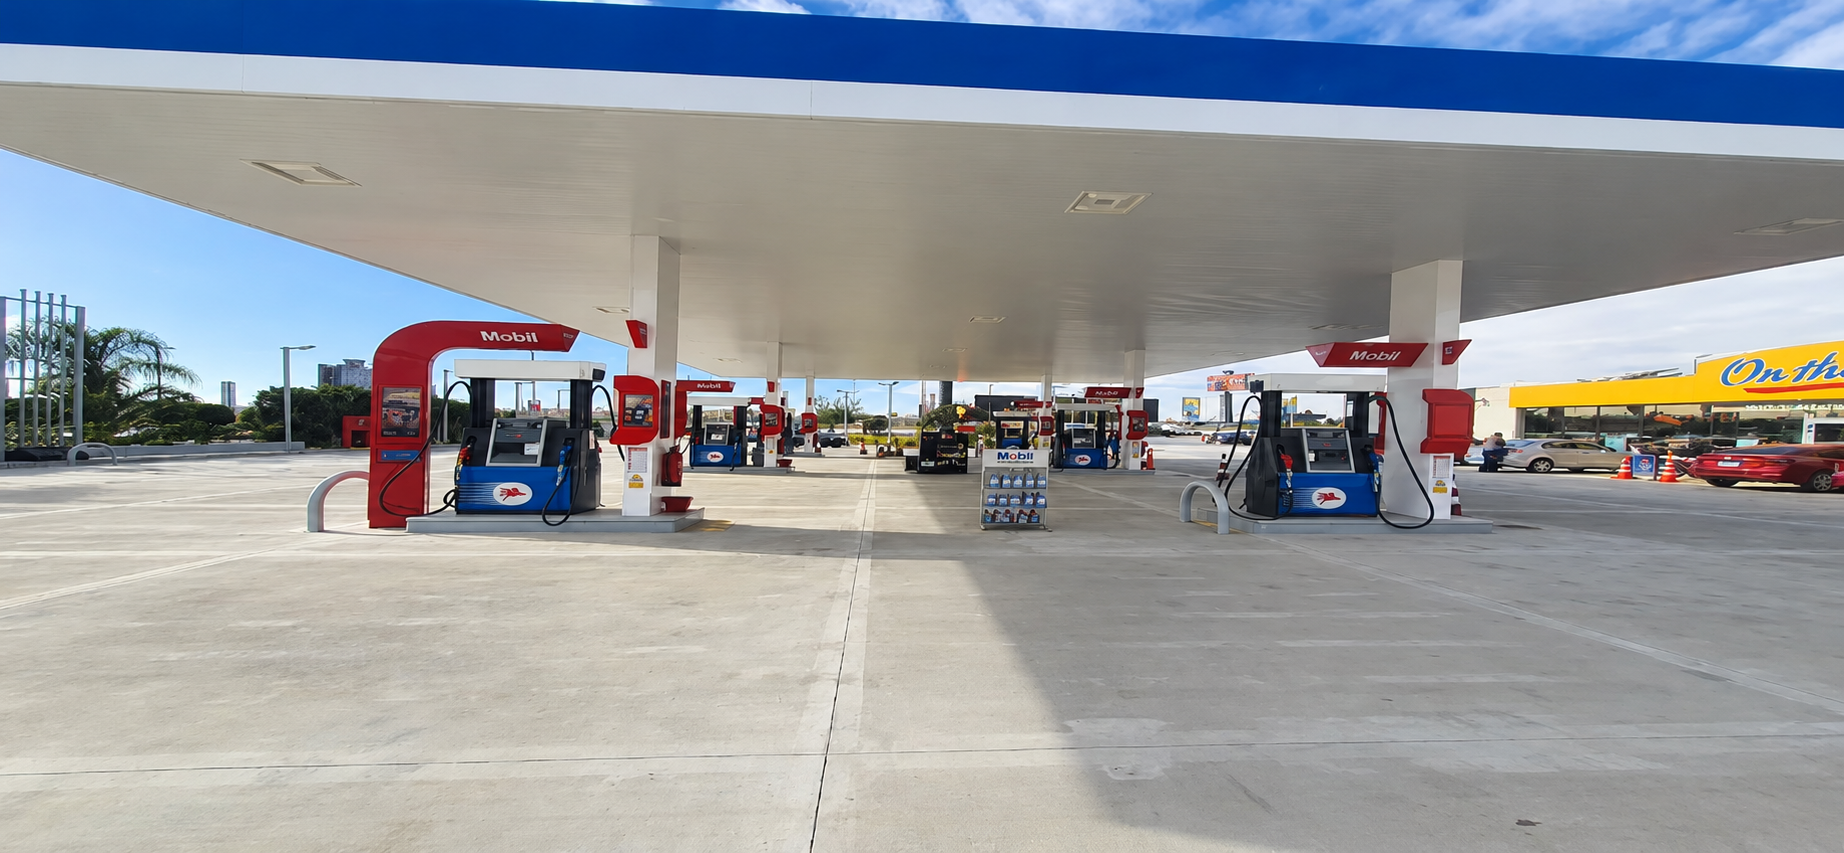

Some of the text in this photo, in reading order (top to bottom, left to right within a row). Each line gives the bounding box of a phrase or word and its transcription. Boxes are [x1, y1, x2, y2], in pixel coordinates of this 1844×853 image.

[480, 330, 539, 343] Mobil
[1349, 350, 1401, 361] Mobil
[1720, 357, 1790, 386] On
[997, 452, 1034, 460] Mobil
